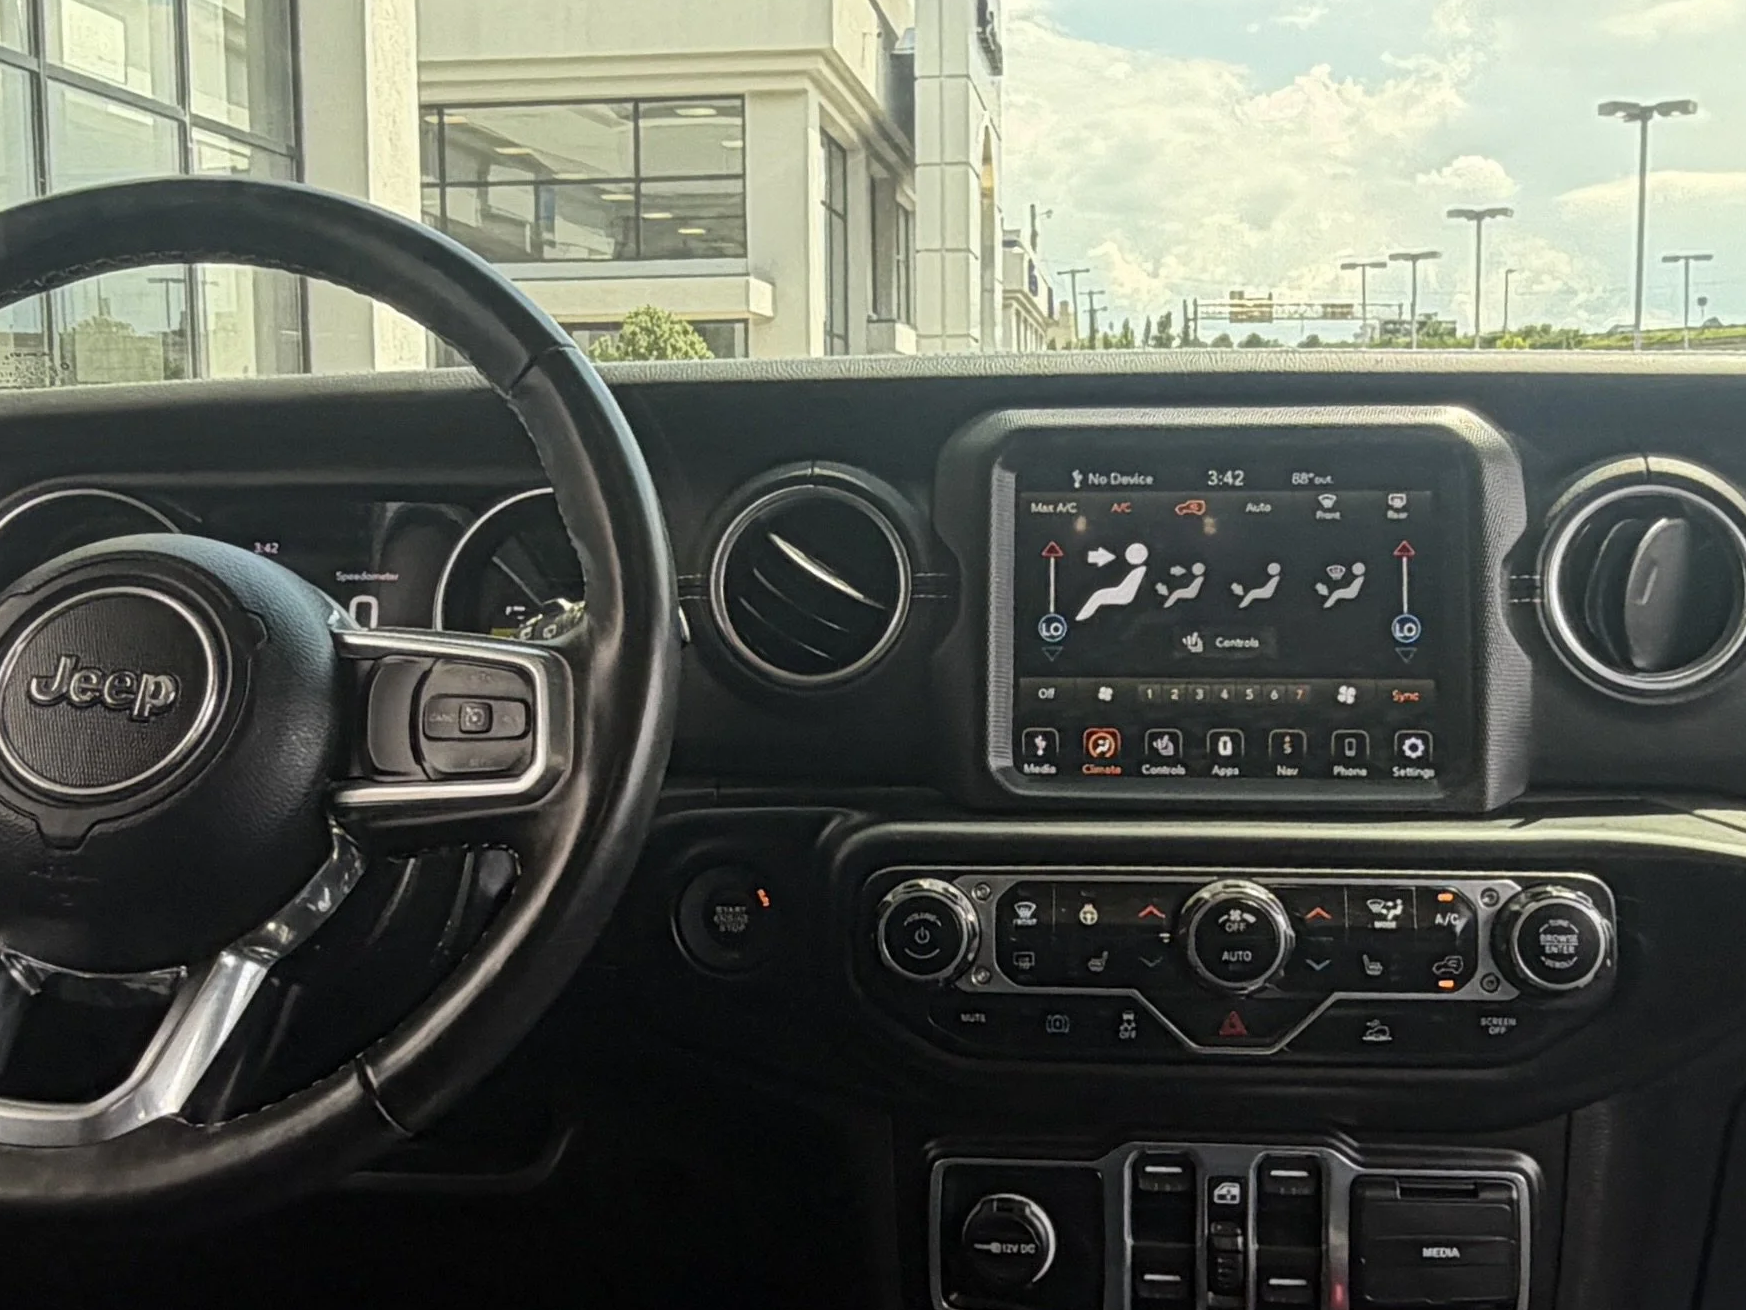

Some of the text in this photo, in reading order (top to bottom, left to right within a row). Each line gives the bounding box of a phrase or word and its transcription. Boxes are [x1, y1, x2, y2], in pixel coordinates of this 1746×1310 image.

[1088, 473, 1154, 485] No Device
[1207, 470, 1245, 487] 3:42
[1030, 502, 1078, 514] Max A/C
[1110, 502, 1132, 513] A/C
[1245, 502, 1272, 513] Auto
[1315, 510, 1341, 521] Front
[1386, 510, 1408, 520] Rear
[254, 542, 279, 555] 3:42
[335, 571, 399, 582] Speedometer
[1041, 623, 1063, 636] LO
[1395, 623, 1417, 637] LO
[1215, 636, 1260, 649] Controls
[29, 653, 180, 721] Jeep
[1038, 688, 1056, 700] Off
[1146, 689, 1305, 700] 1 2 3 4 5 6 7
[1392, 689, 1420, 703] Sync
[1023, 763, 1057, 775] Media
[1082, 763, 1122, 775] Climate
[1141, 763, 1187, 776] Controls
[1211, 764, 1240, 777] Apps
[1276, 764, 1299, 776] Nav
[1333, 765, 1368, 777] Phone
[1392, 766, 1435, 779] Settings
[1434, 913, 1459, 926] A/C
[1225, 922, 1246, 934] OFF
[1539, 934, 1579, 945] BROWSE
[1544, 945, 1575, 955] ENTER
[1221, 951, 1252, 963] AUTO
[960, 1012, 986, 1023] MUTE
[1480, 1017, 1517, 1027] SCREEN
[1119, 1029, 1137, 1039] OFF
[1489, 1026, 1506, 1035] OFF
[1002, 1242, 1036, 1256] 12V DC
[1422, 1246, 1460, 1259] MEDIA
